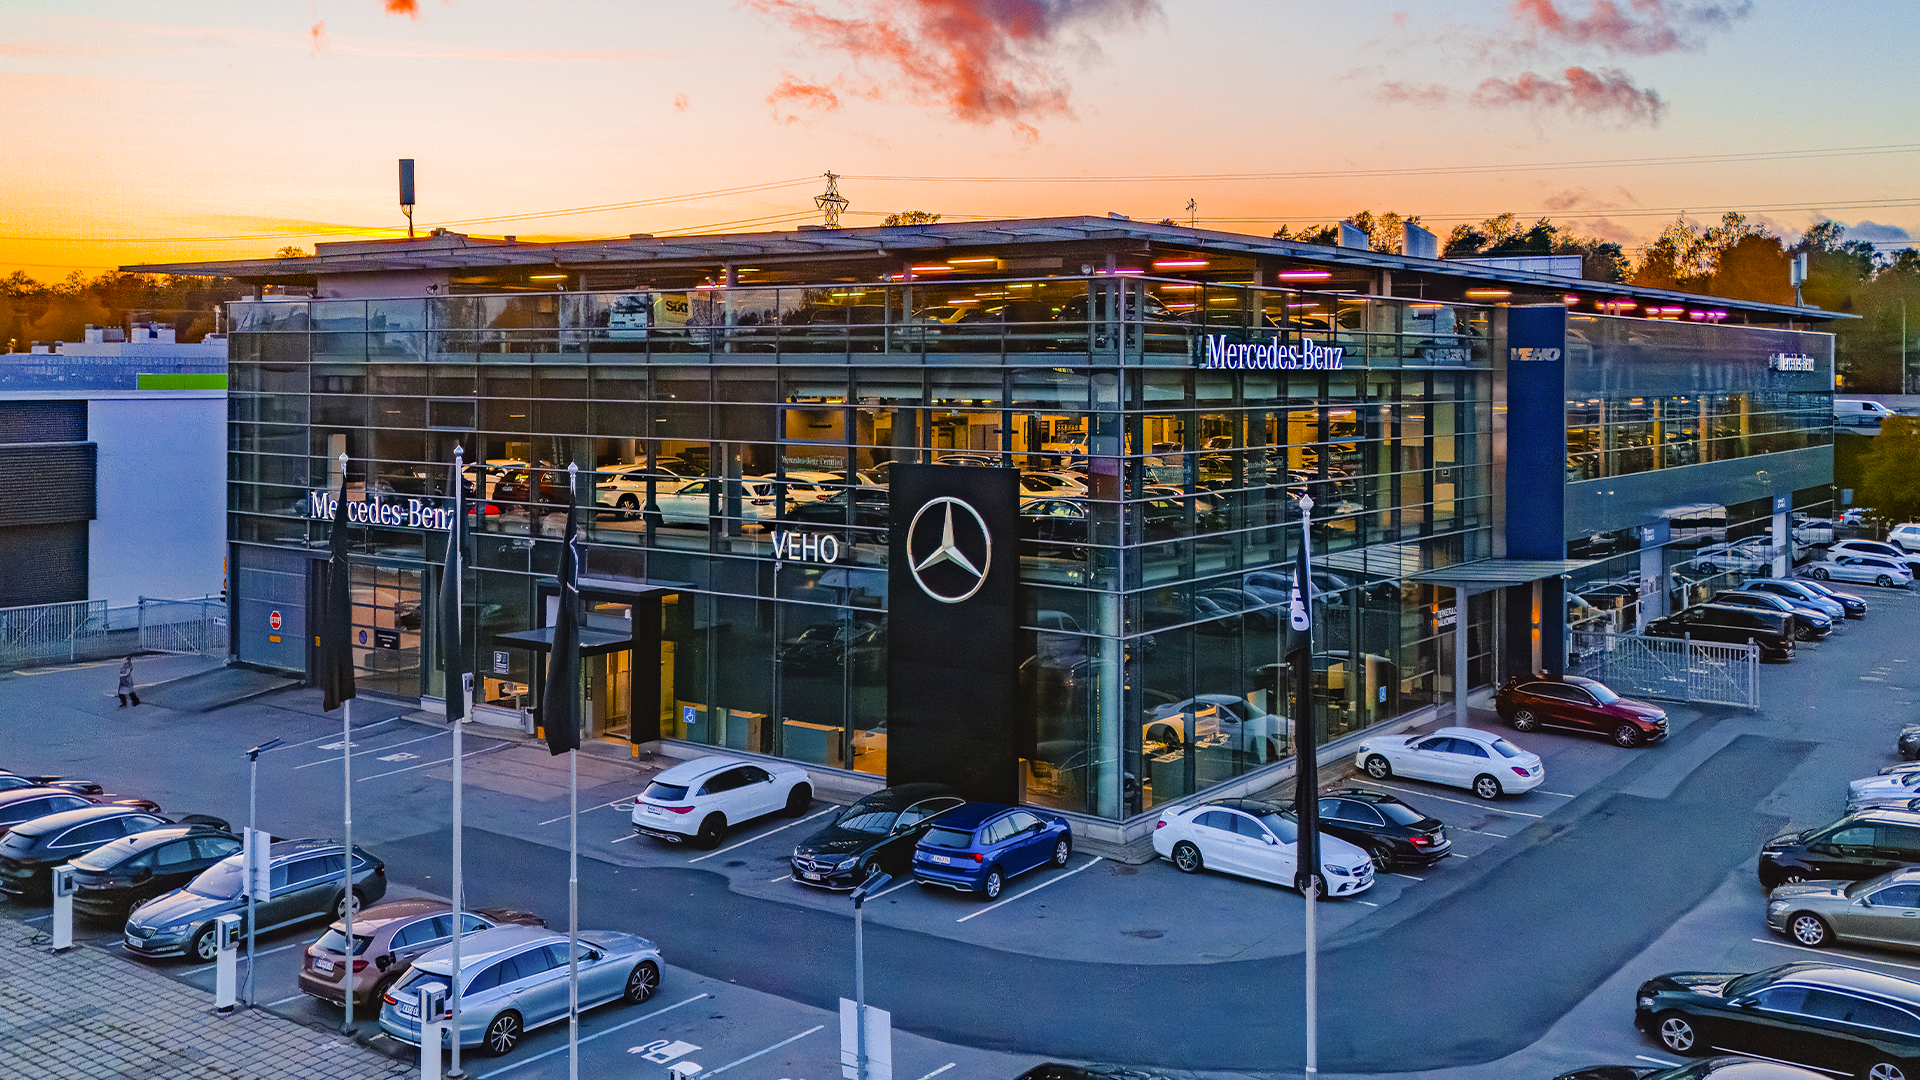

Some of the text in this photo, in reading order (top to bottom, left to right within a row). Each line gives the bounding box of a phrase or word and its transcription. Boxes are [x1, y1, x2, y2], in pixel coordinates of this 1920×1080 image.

[1207, 334, 1343, 371] Mercedes-Benz
[1510, 347, 1561, 362] VEHO
[310, 491, 455, 531] Mecedes-Benz
[770, 530, 839, 564] VEHO
